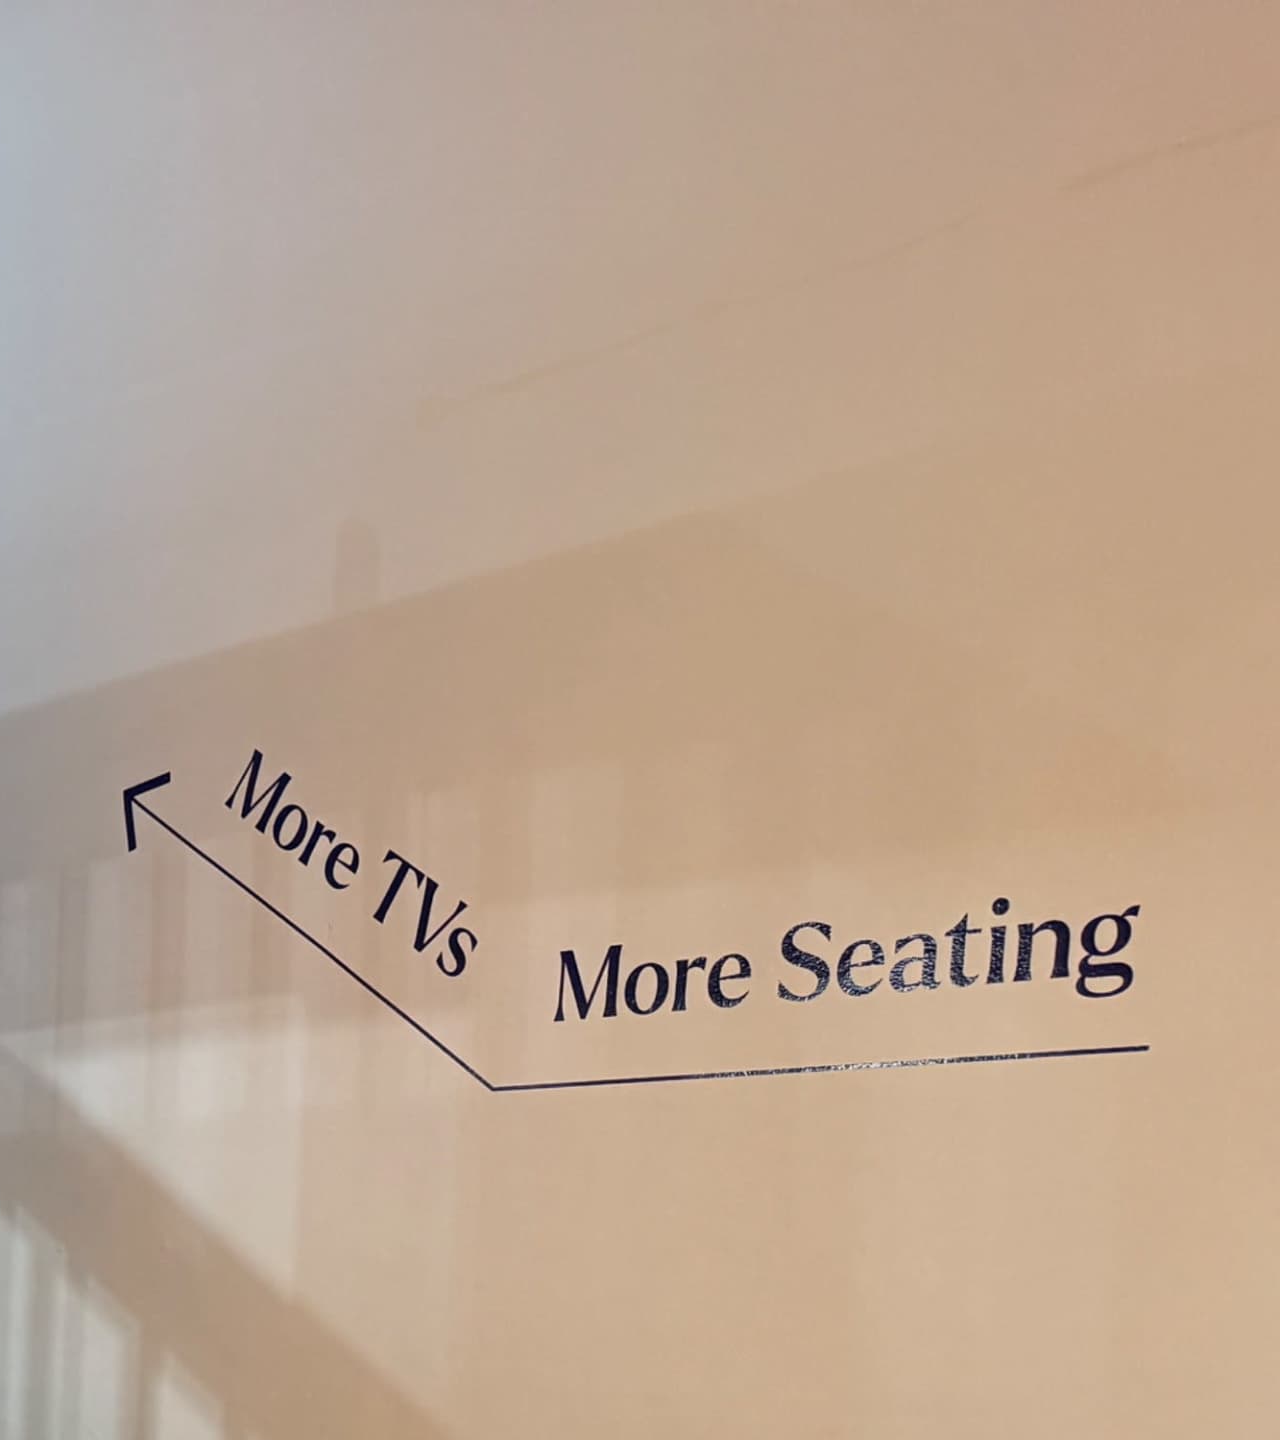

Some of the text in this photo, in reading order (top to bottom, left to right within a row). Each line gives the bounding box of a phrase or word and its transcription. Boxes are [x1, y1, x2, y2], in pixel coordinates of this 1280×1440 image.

[224, 748, 479, 978] More TVs
[553, 897, 1141, 1022] More Seating
